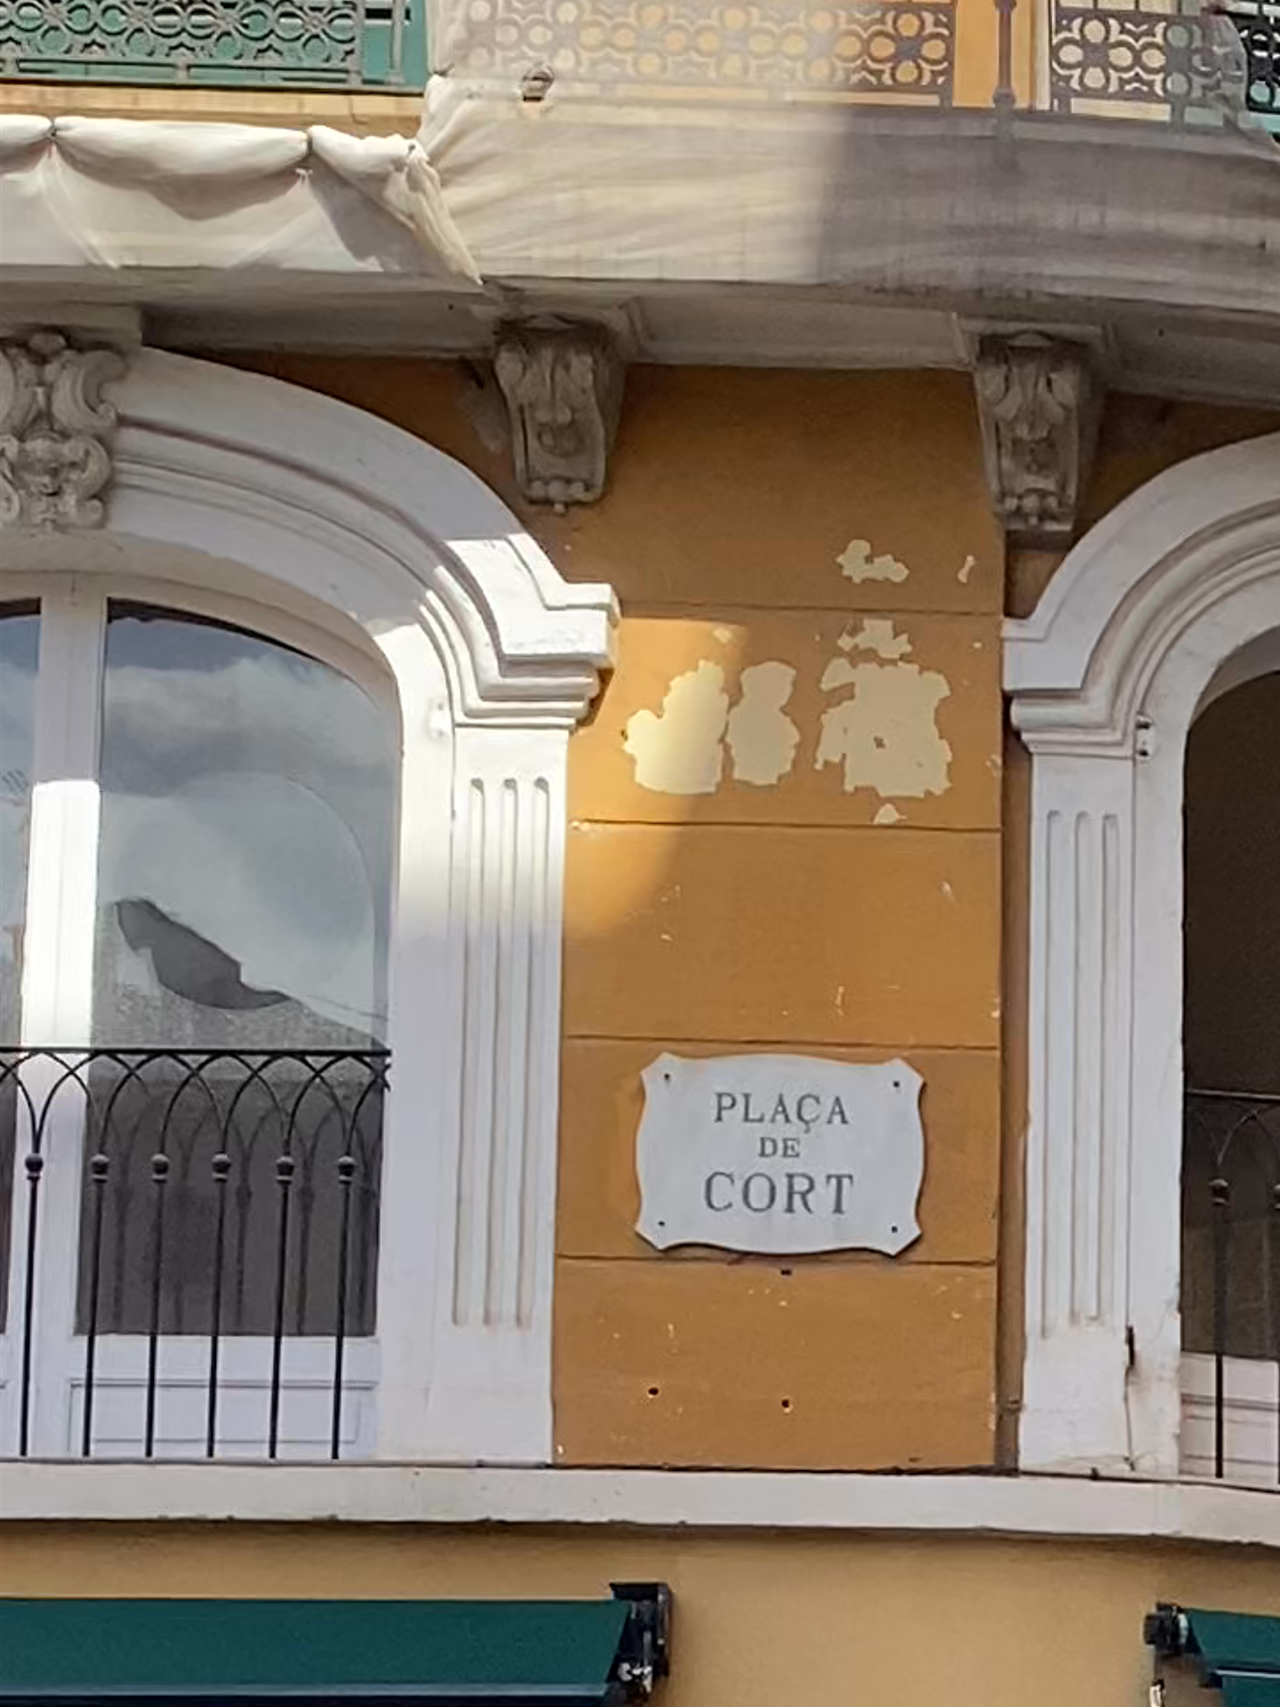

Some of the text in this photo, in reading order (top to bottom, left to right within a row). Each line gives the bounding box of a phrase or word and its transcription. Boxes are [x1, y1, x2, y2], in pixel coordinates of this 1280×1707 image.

[713, 1092, 849, 1134] PLAÇA
[758, 1137, 801, 1159] DE
[704, 1170, 854, 1215] CORT
